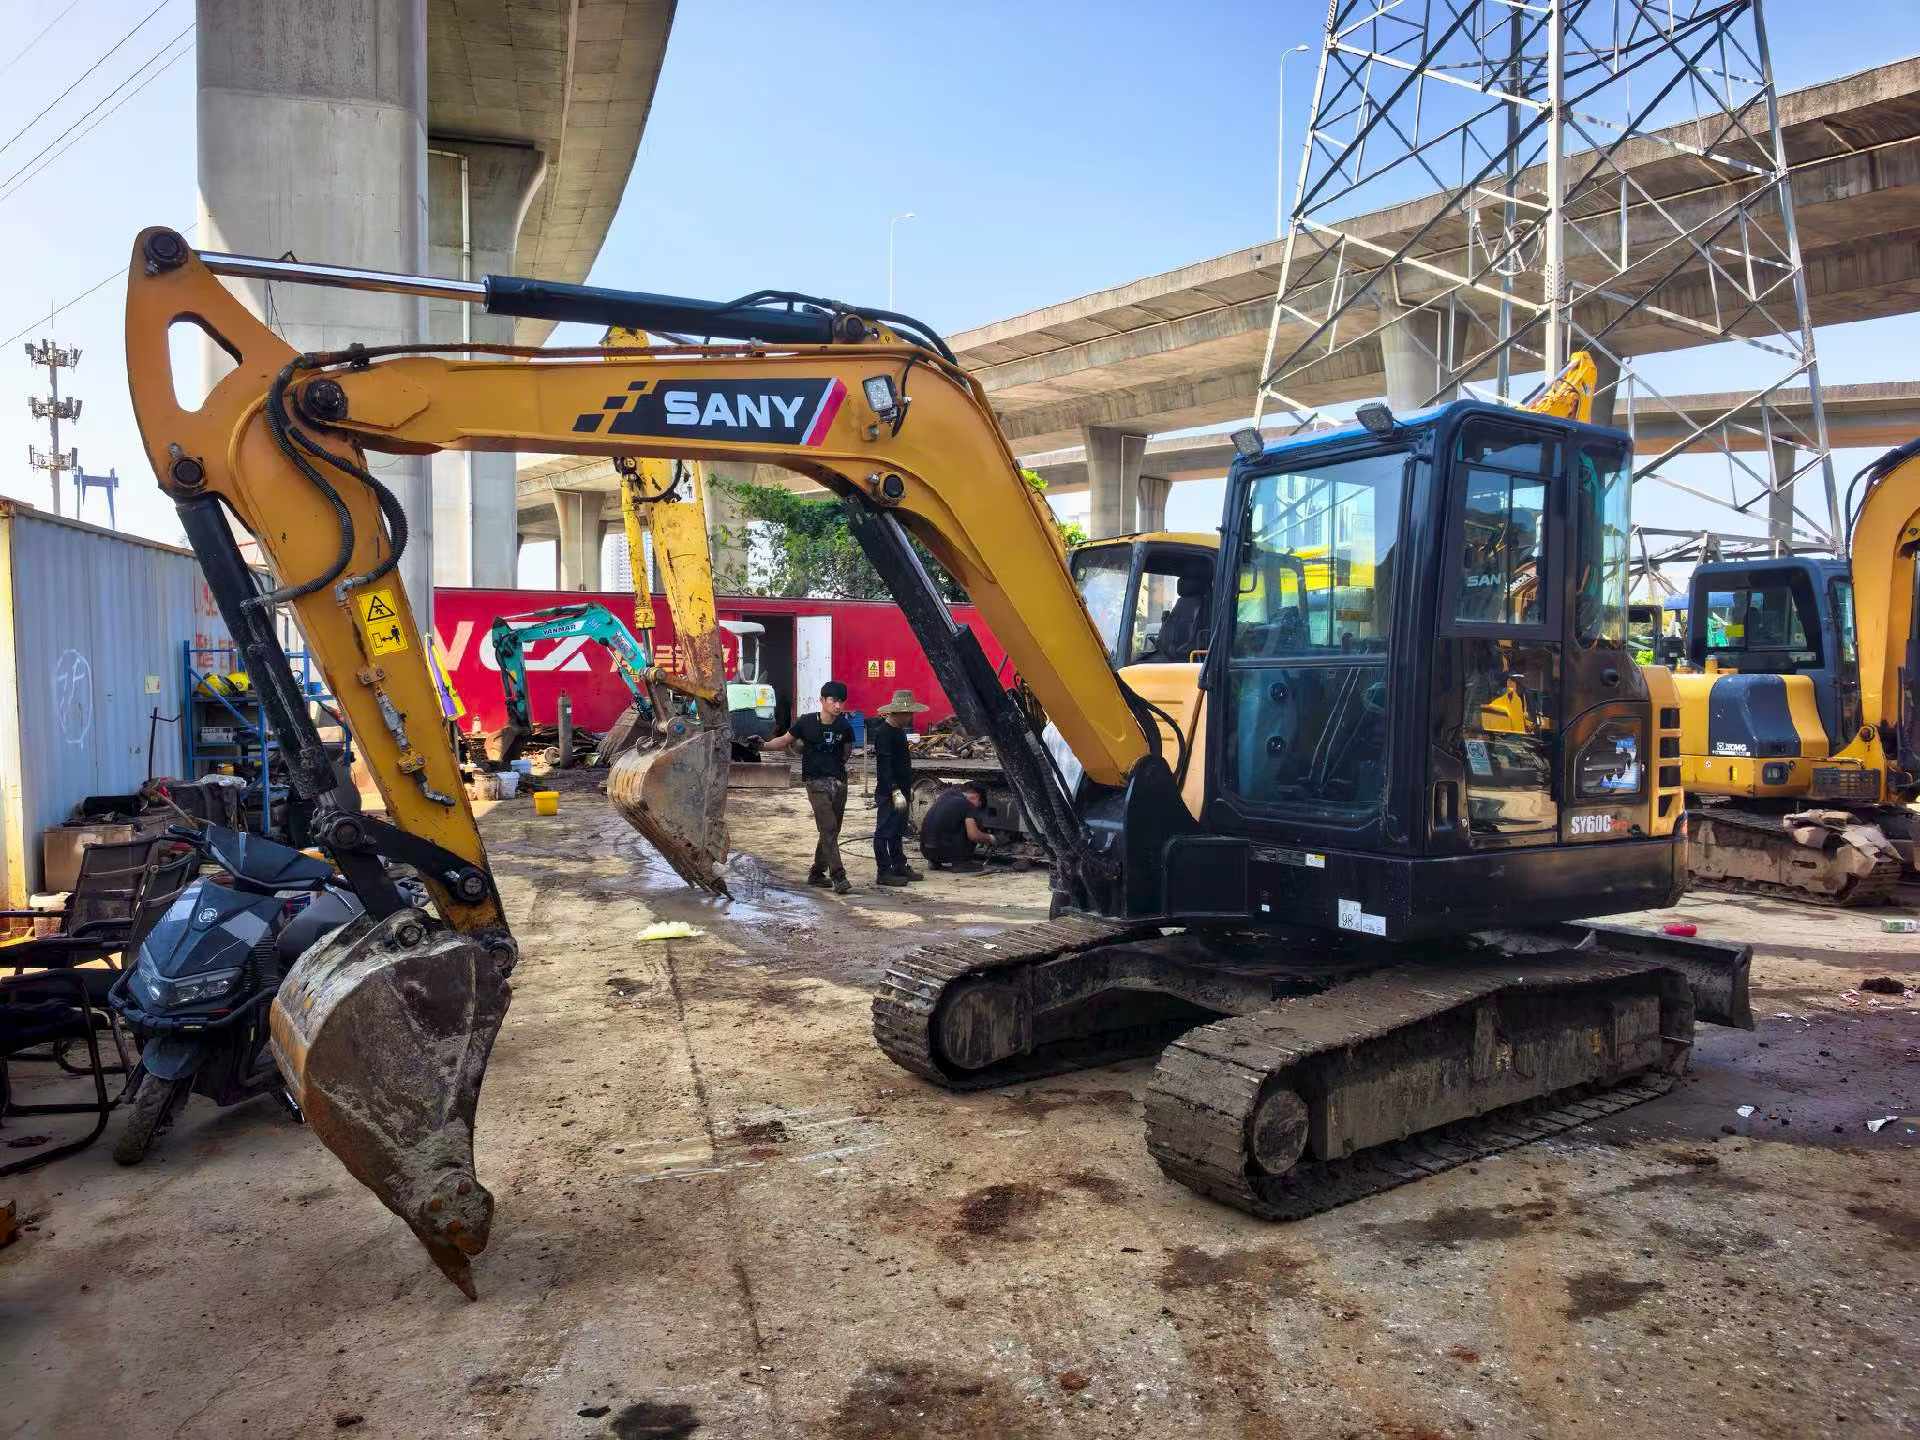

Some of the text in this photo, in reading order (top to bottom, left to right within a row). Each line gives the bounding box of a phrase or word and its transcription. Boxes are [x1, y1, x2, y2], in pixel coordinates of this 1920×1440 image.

[664, 390, 805, 428] SANY
[543, 624, 576, 635] YANMAR
[1571, 814, 1612, 834] SY60C
